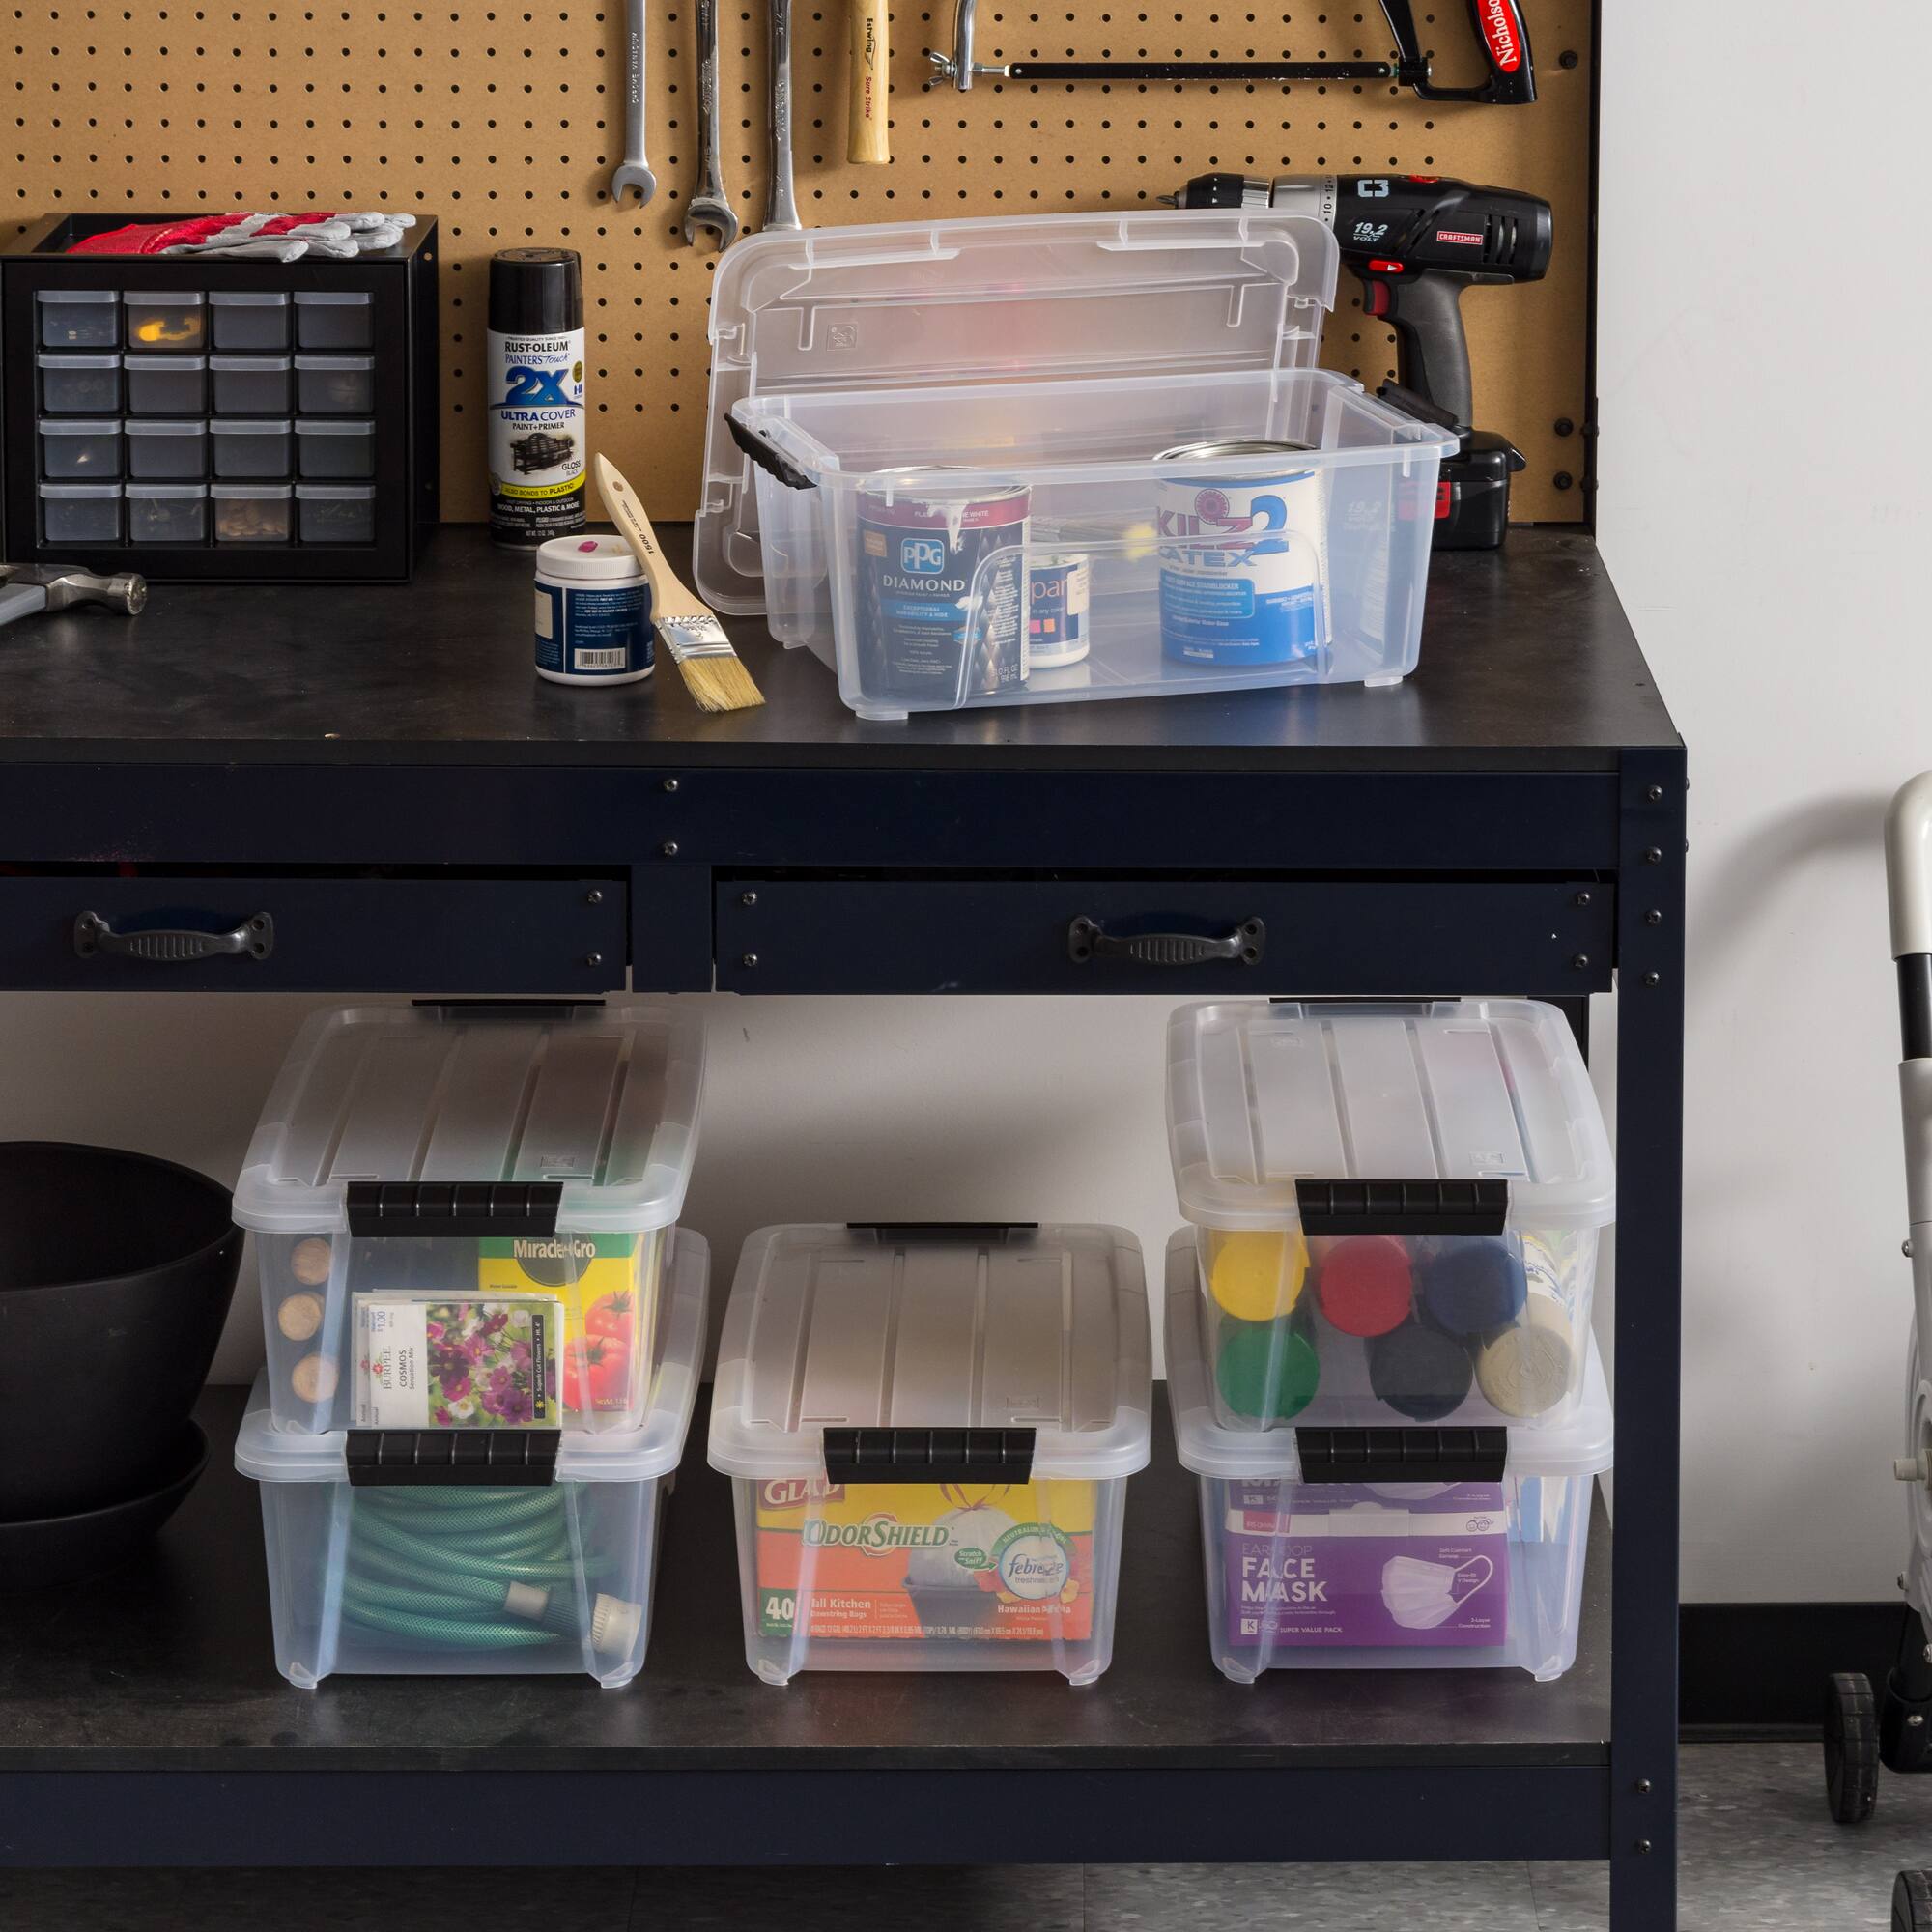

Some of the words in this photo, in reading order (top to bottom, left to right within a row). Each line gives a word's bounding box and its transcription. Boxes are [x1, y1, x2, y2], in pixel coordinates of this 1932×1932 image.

[866, 17, 874, 53] Estwing
[865, 96, 873, 118] Strike
[1325, 184, 1334, 192] 12
[1357, 180, 1389, 197] C3
[1323, 203, 1332, 214] 10
[1354, 222, 1388, 236] 19.2
[1439, 233, 1482, 243] CRAFTSMAN
[505, 341, 568, 353] RUST-OLEUM
[505, 365, 569, 406] 2X
[500, 410, 539, 421] ULTRA
[540, 408, 576, 420] COVER
[562, 460, 582, 470] GLOSS
[1250, 494, 1290, 556] 2
[638, 533, 655, 555] 1500
[903, 542, 942, 570] PPG
[883, 575, 966, 592] DIAMOND
[383, 1347, 392, 1390] BURPEE
[399, 1350, 408, 1388] COSMOS
[1242, 1556, 1315, 1579] FACE
[1241, 1581, 1328, 1602] MASK
[765, 1597, 795, 1621] 40
[830, 1598, 871, 1609] Kitchen
[998, 1605, 1040, 1614] Hawaiian
